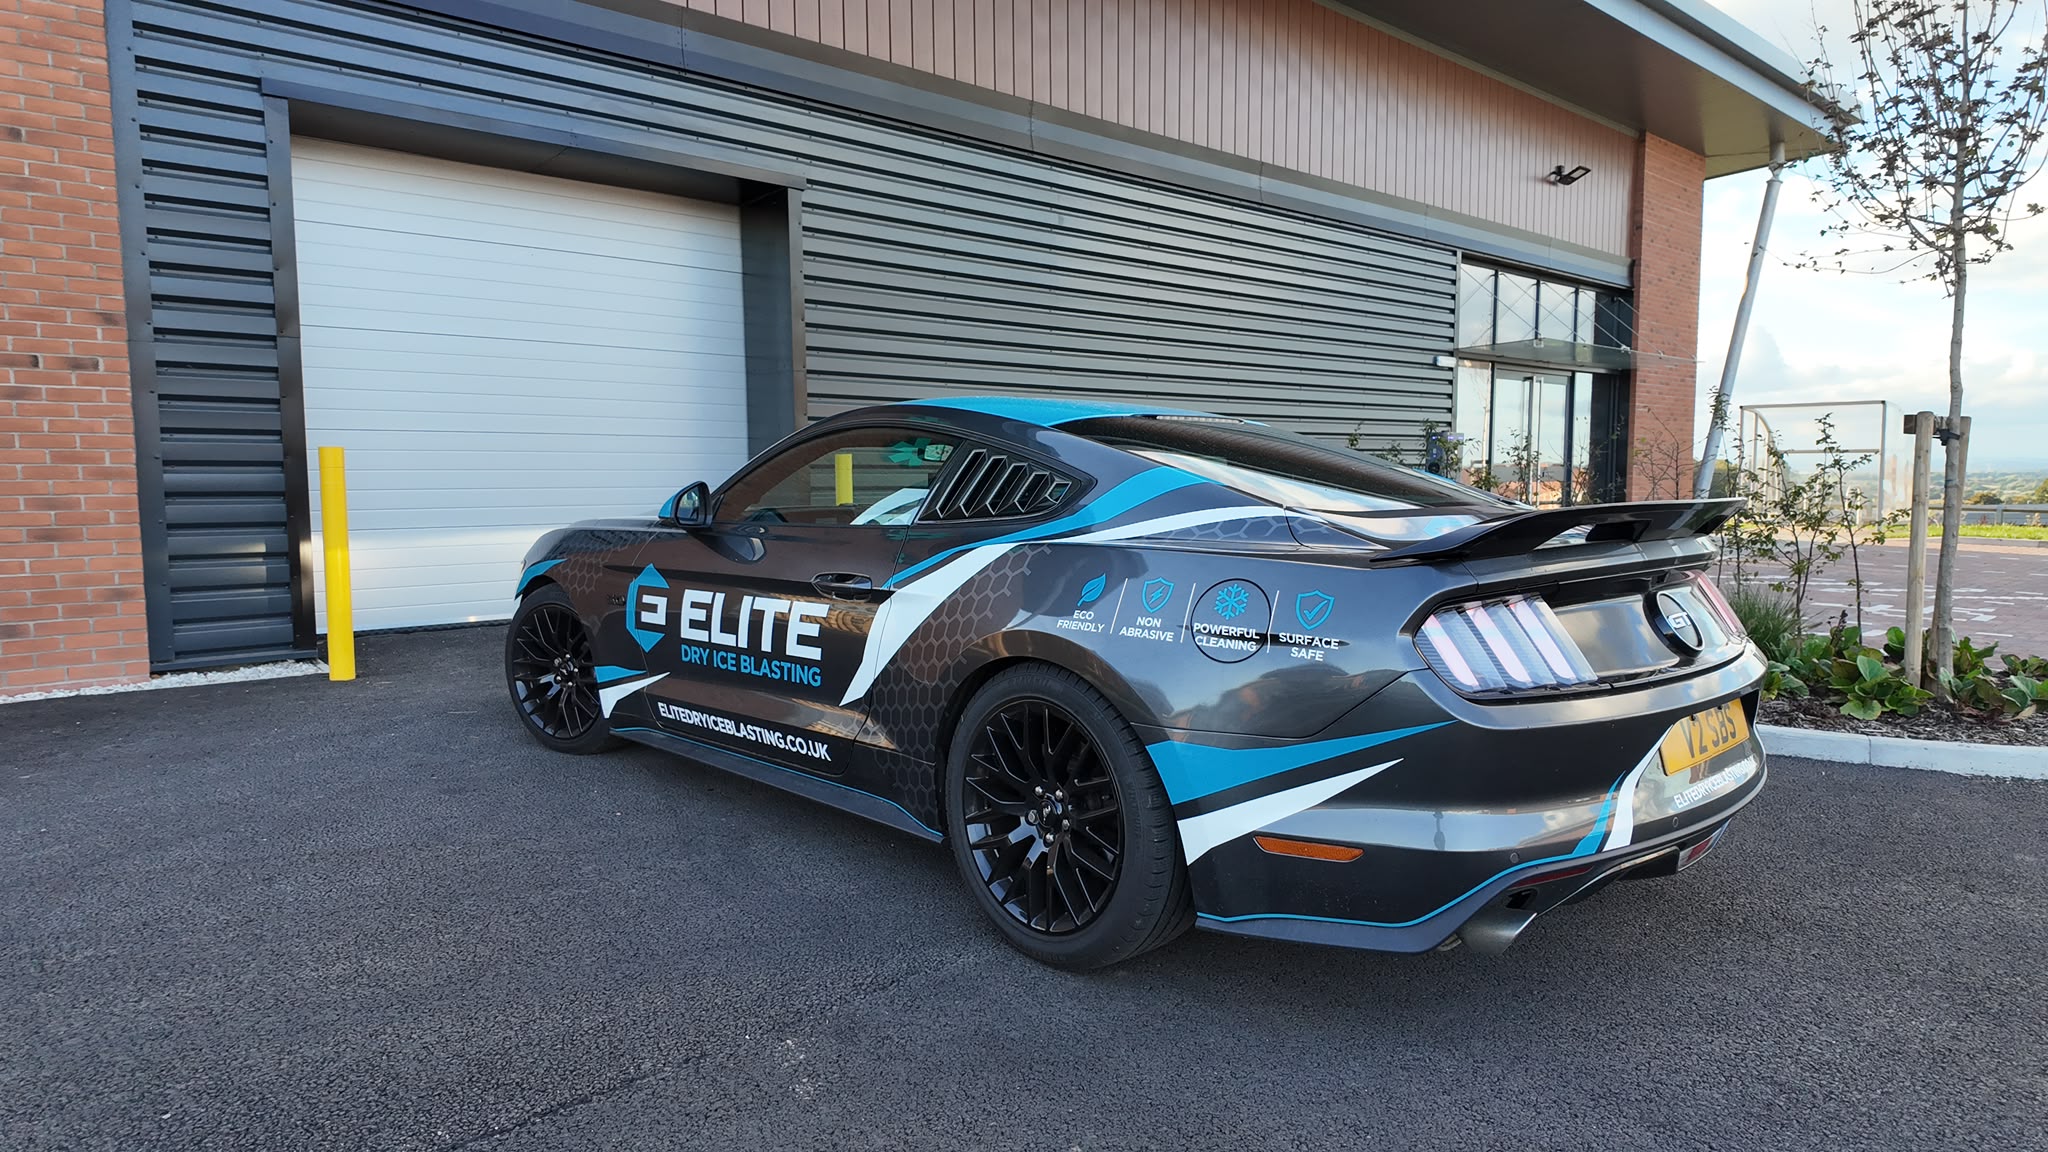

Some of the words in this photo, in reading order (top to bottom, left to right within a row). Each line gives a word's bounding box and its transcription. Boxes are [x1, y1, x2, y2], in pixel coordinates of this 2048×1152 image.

[1073, 610, 1094, 621] ECO
[1136, 616, 1161, 628] NON
[1666, 611, 1692, 629] GT
[680, 589, 830, 661] ELITE
[1056, 619, 1105, 633] FRIENDLY
[1192, 622, 1260, 639] POWERFUL
[1119, 626, 1174, 642] ABRASIVE
[1278, 632, 1340, 650] SURFACE
[1195, 635, 1257, 652] CLEANING
[1290, 646, 1324, 662] SAFE
[681, 644, 709, 666] DRY
[713, 650, 737, 671] ICE
[740, 657, 822, 687] BLASTING
[657, 702, 831, 762] ELITEDRYICEBLASTING.CO.UK
